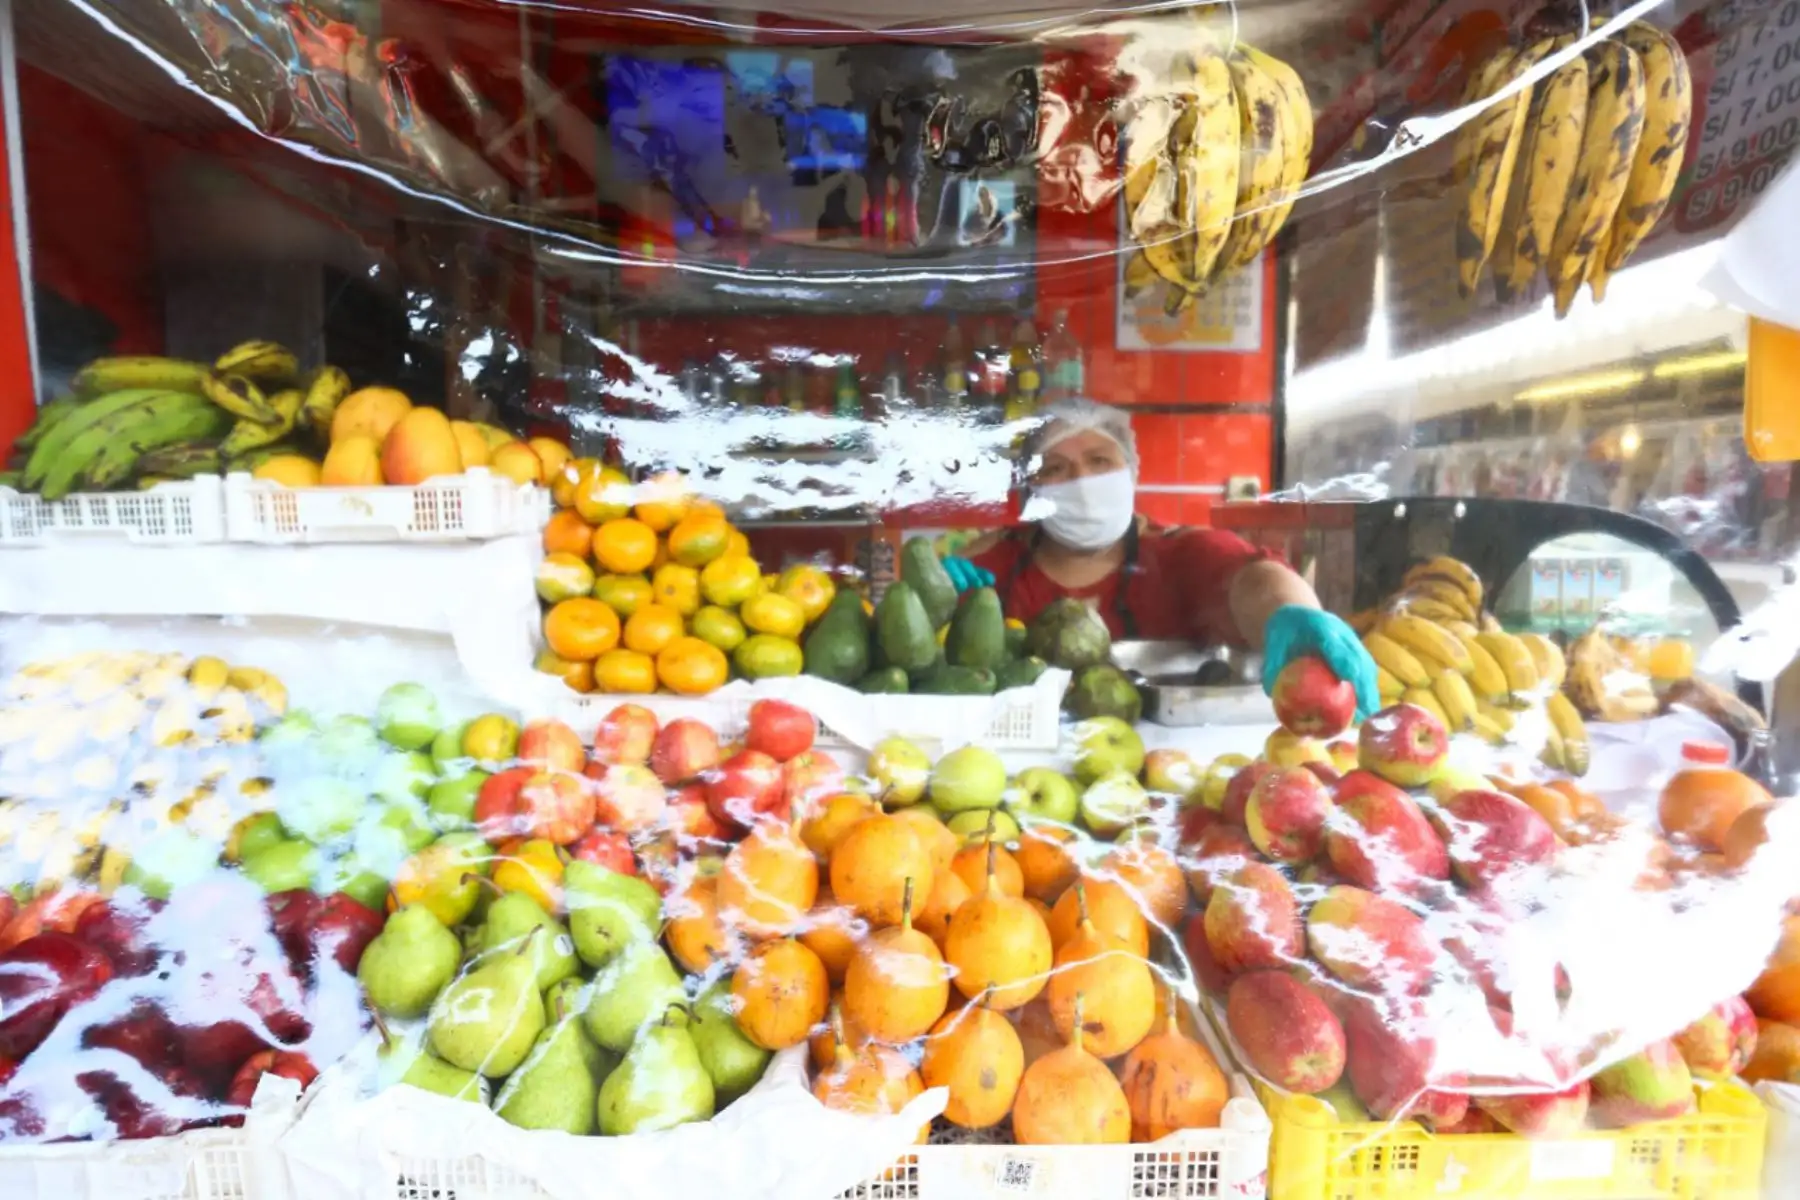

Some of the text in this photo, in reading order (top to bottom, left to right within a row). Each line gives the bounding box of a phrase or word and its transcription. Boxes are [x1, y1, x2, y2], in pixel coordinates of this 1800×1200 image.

[1709, 68, 1738, 105] S/
[1703, 108, 1732, 142] S/
[1697, 145, 1726, 180] S/
